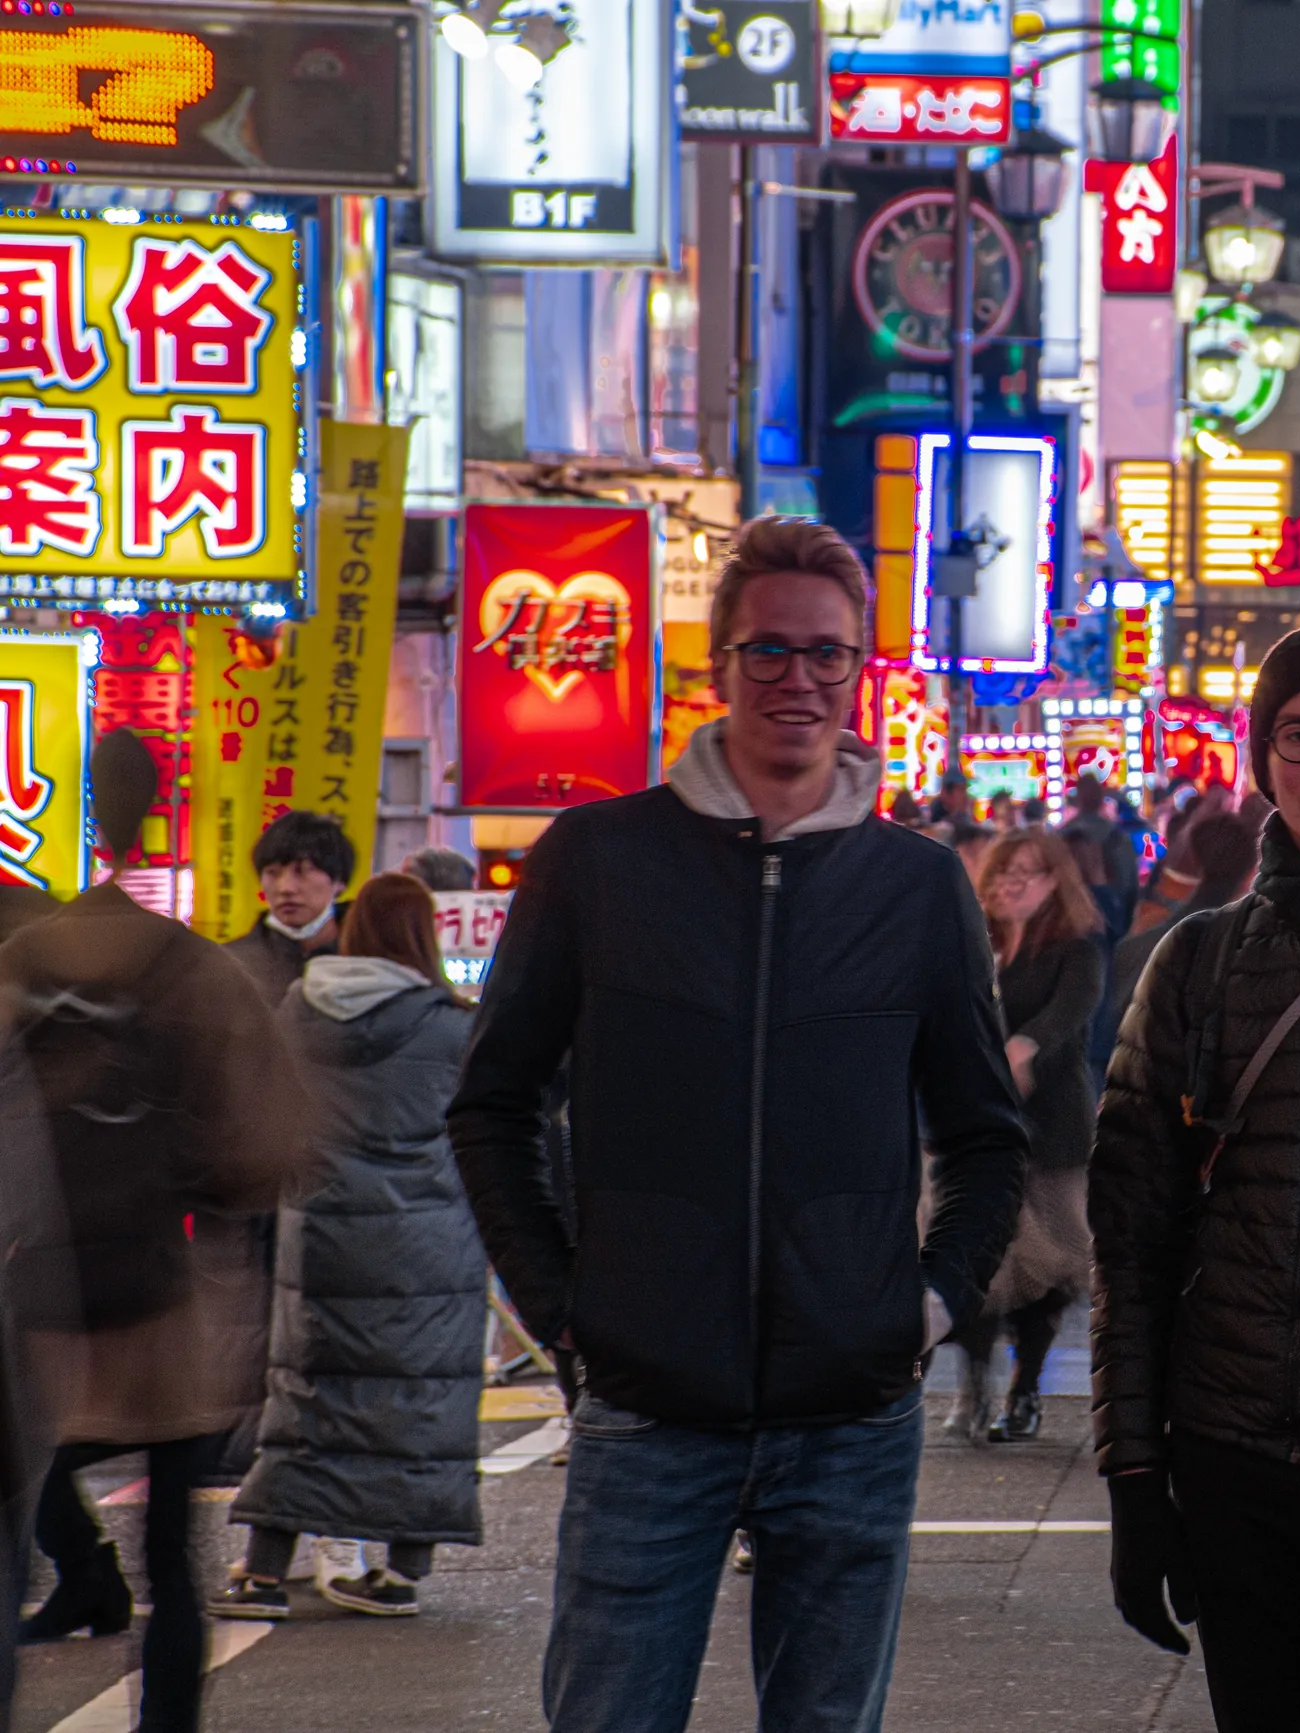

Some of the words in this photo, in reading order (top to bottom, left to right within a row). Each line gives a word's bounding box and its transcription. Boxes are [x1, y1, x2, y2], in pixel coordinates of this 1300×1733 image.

[747, 26, 786, 57] 2F
[510, 189, 597, 228] B1F
[0, 234, 275, 395] 風俗
[0, 397, 268, 559] 案内
